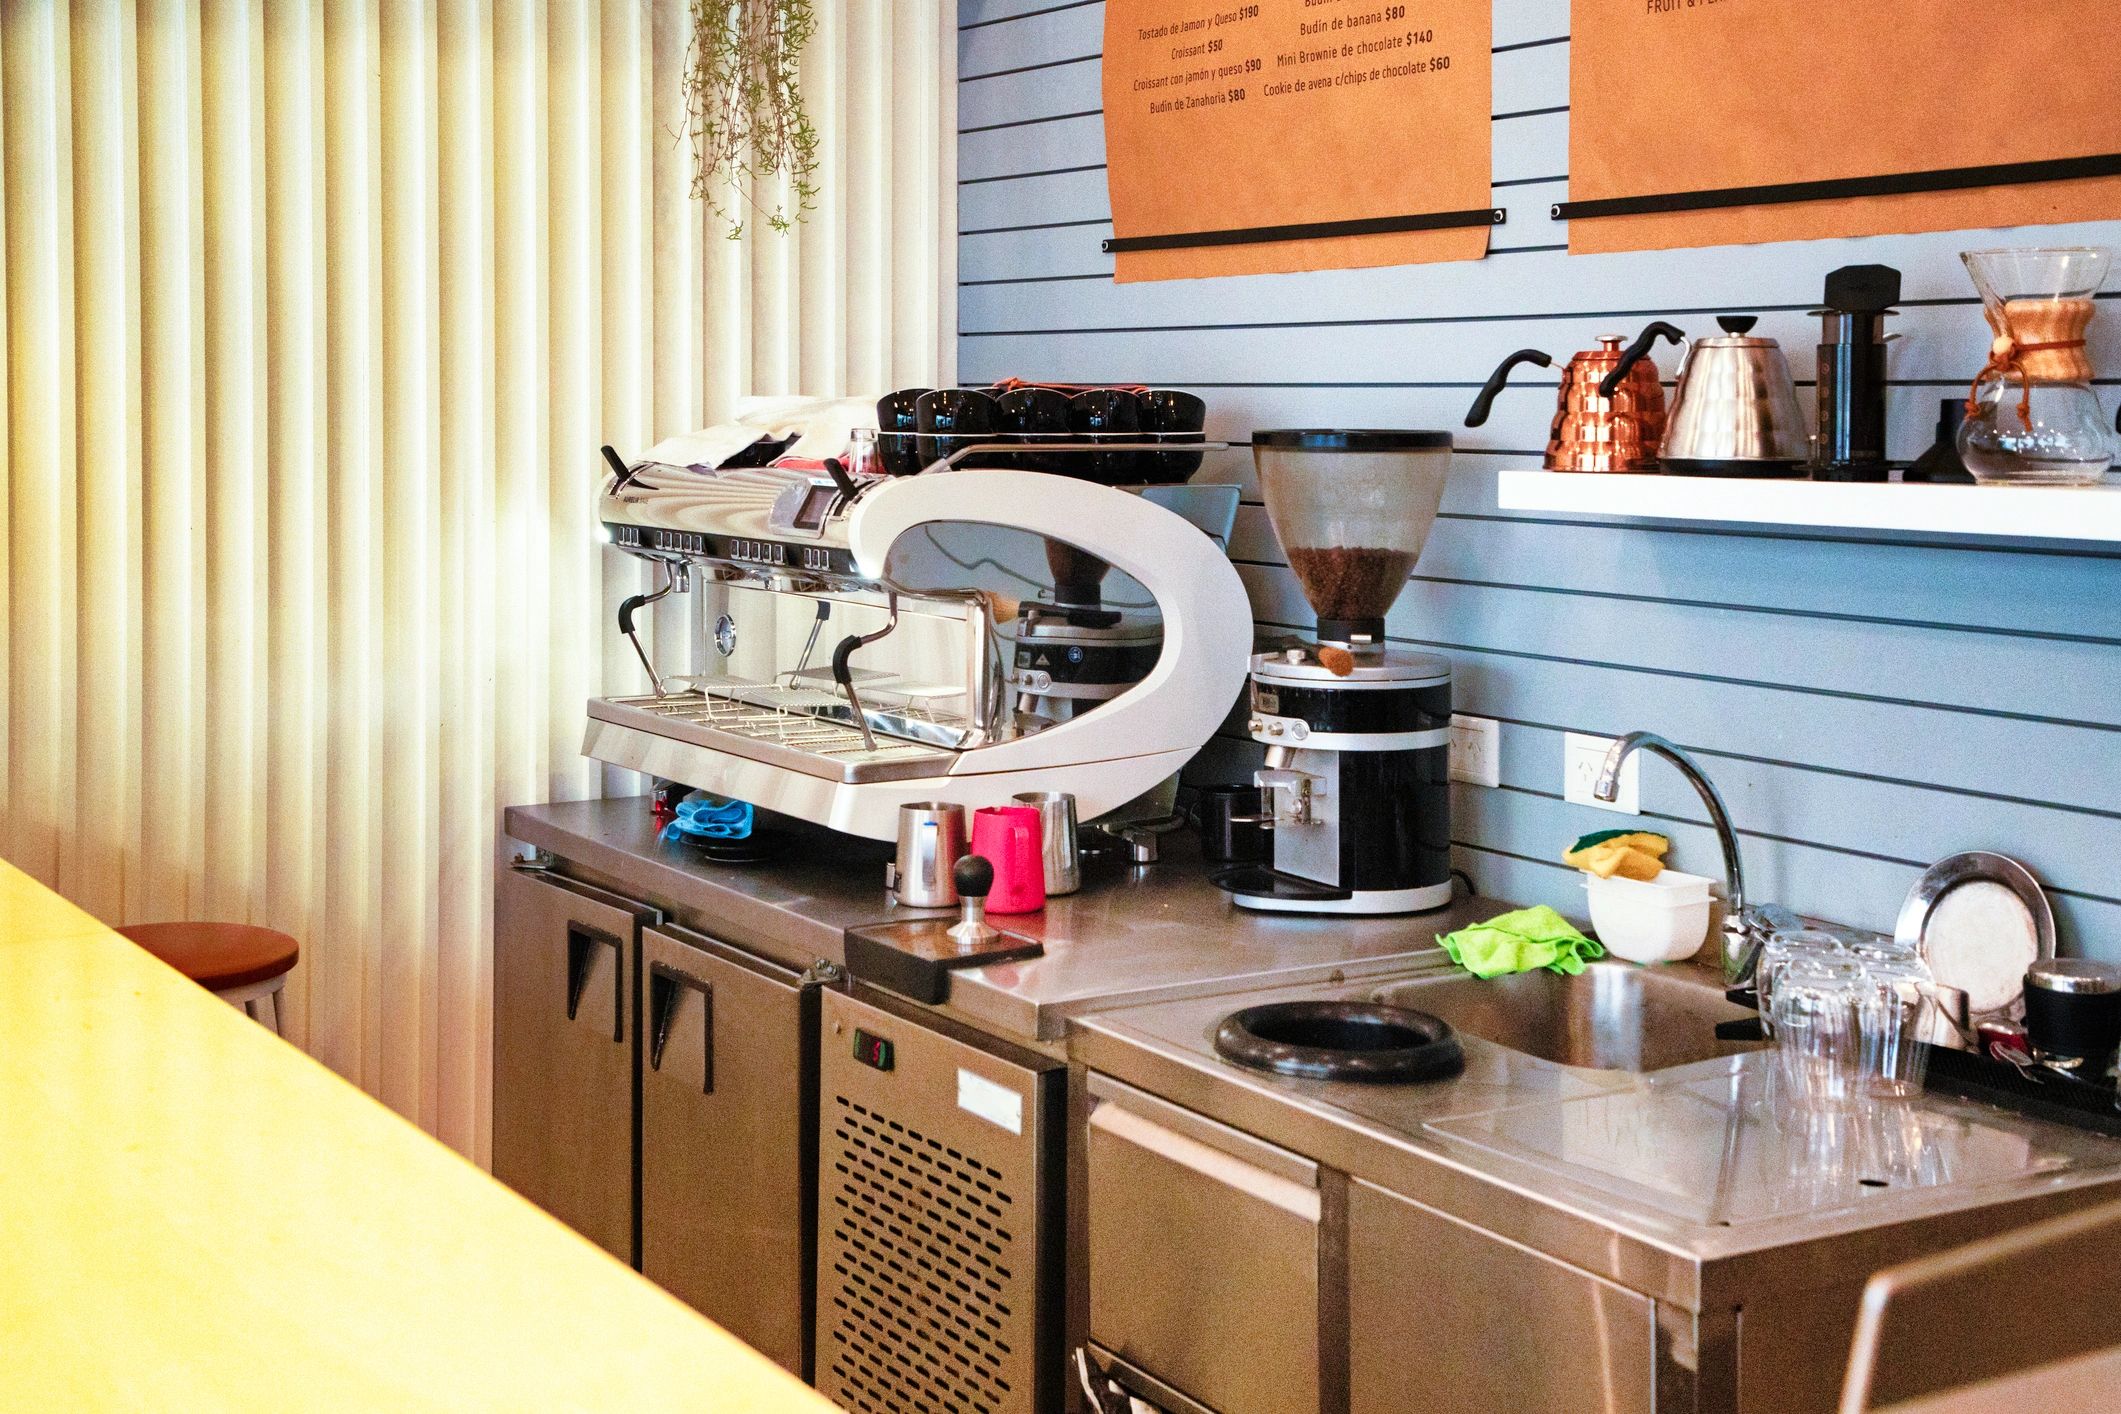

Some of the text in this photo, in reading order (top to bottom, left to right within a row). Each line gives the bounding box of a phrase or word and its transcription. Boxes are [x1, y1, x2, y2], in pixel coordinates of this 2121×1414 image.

[1138, 27, 1168, 41] Tostado
[1169, 22, 1179, 34] de
[1207, 17, 1213, 30] y
[1214, 11, 1237, 26] Queso
[1239, 4, 1259, 21] $190
[1300, 5, 1405, 36] Budín de banana $80
[1171, 38, 1223, 60] Croissant $50
[1277, 29, 1433, 68] Mini Brownie de chocolate $140
[1133, 76, 1168, 92] Croissant
[1170, 74, 1183, 86] con
[1211, 69, 1216, 82] y
[1218, 64, 1243, 80] queso
[1245, 58, 1262, 74] $90
[1263, 56, 1450, 97] Cookie de avena c/chips de chocolate $60
[1174, 97, 1184, 111] de
[1186, 91, 1226, 109] Zanahoria
[1228, 88, 1245, 104] $80
